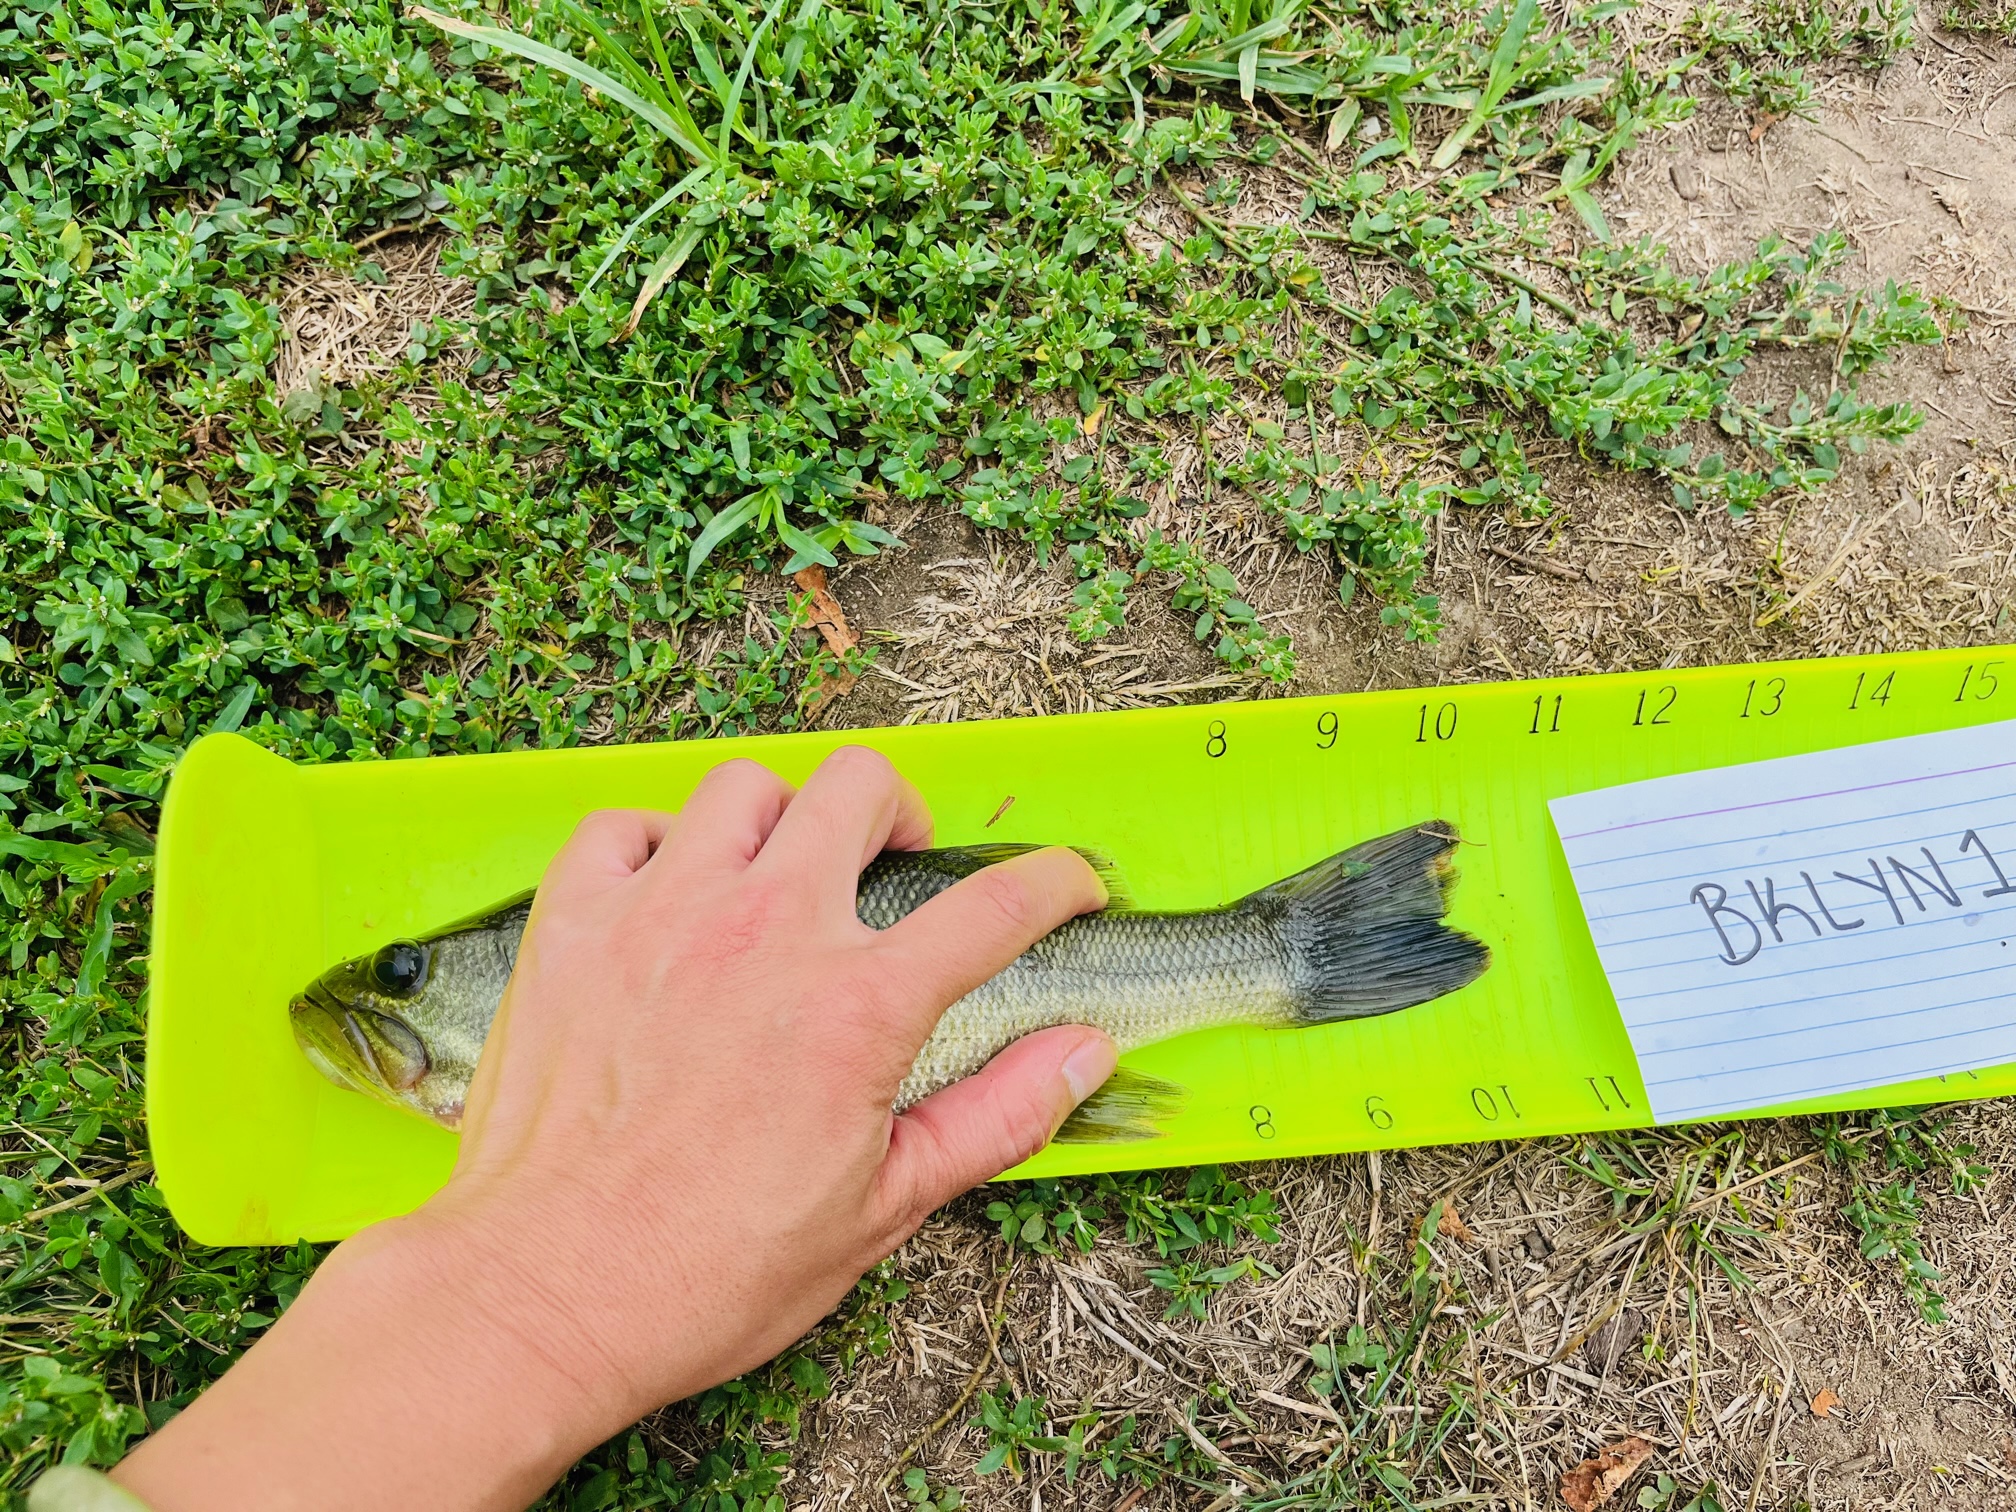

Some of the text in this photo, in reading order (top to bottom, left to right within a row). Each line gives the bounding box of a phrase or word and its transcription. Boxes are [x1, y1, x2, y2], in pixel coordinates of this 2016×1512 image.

[1205, 661, 2005, 758] 8 9 10 11 12 13 14 15
[1249, 1105, 1276, 1139] 8
[1471, 1085, 1520, 1122] 10
[1584, 1076, 1630, 1112] 11
